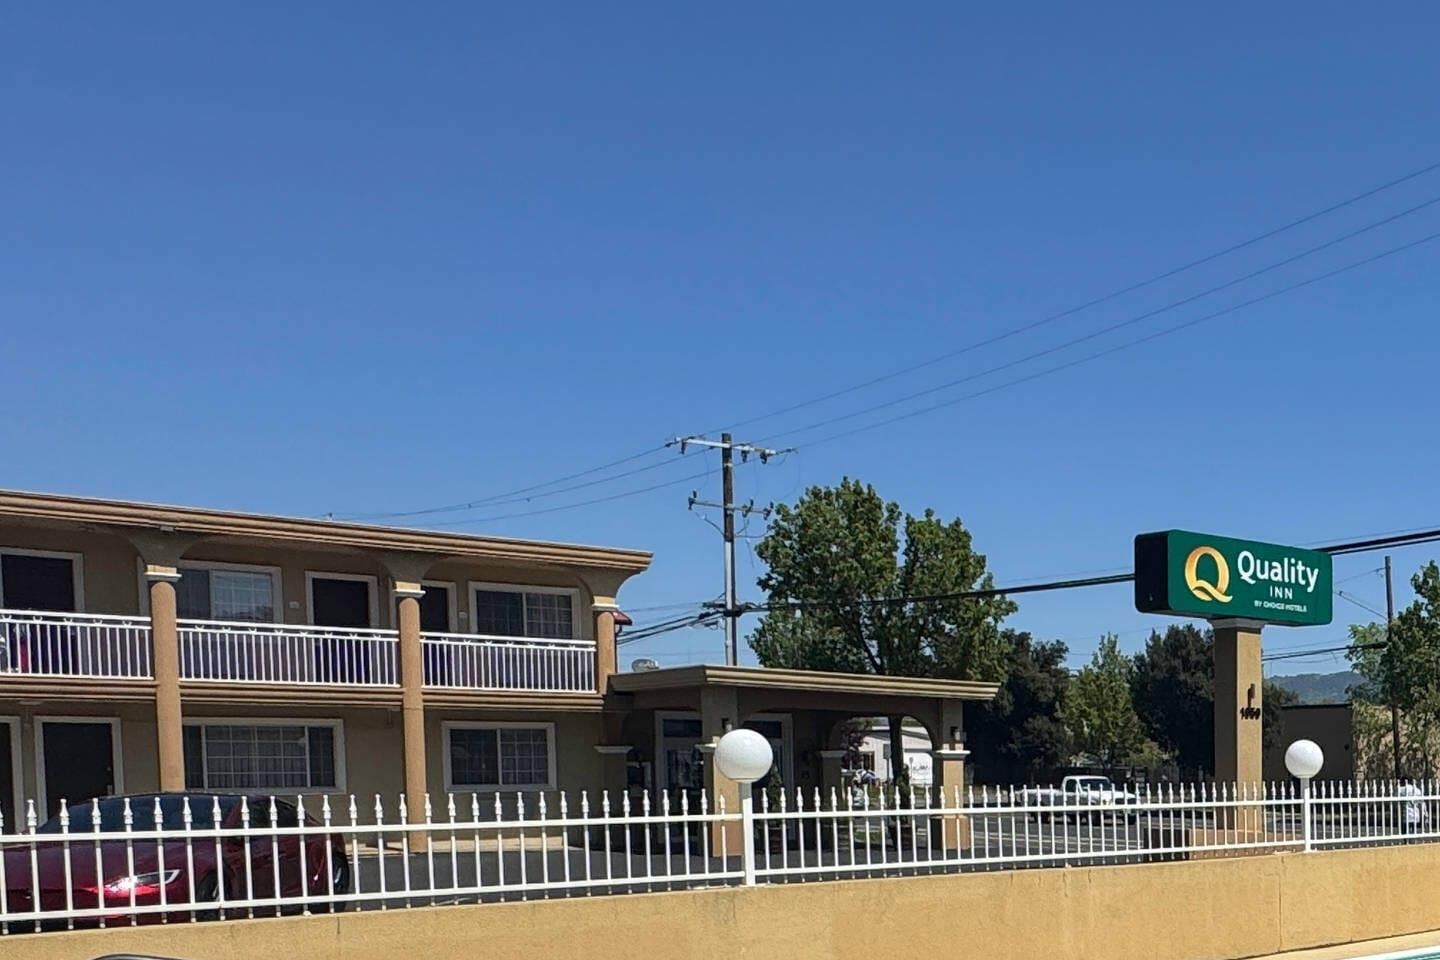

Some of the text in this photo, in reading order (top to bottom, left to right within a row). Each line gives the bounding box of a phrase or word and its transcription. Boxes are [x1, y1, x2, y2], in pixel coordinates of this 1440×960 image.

[1185, 546, 1233, 603] Q
[1237, 550, 1319, 593] Quality
[1270, 585, 1293, 600] INN
